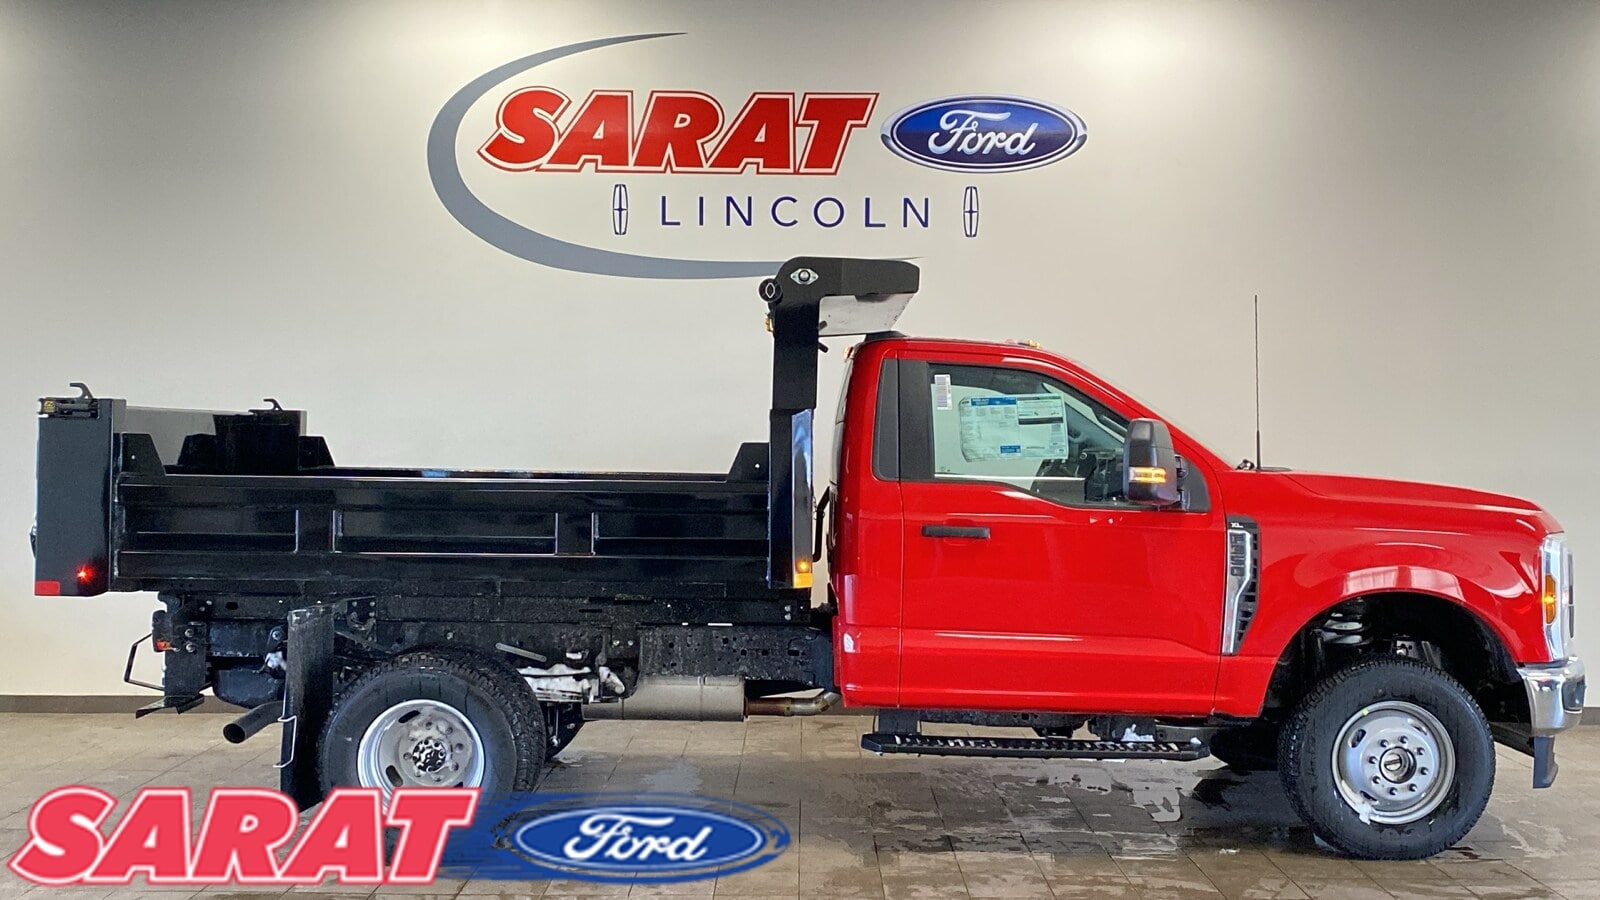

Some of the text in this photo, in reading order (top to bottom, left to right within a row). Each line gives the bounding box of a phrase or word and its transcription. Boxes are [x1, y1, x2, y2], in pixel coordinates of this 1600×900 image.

[477, 85, 1039, 176] SARAT Ford
[661, 195, 929, 228] LINCOLN
